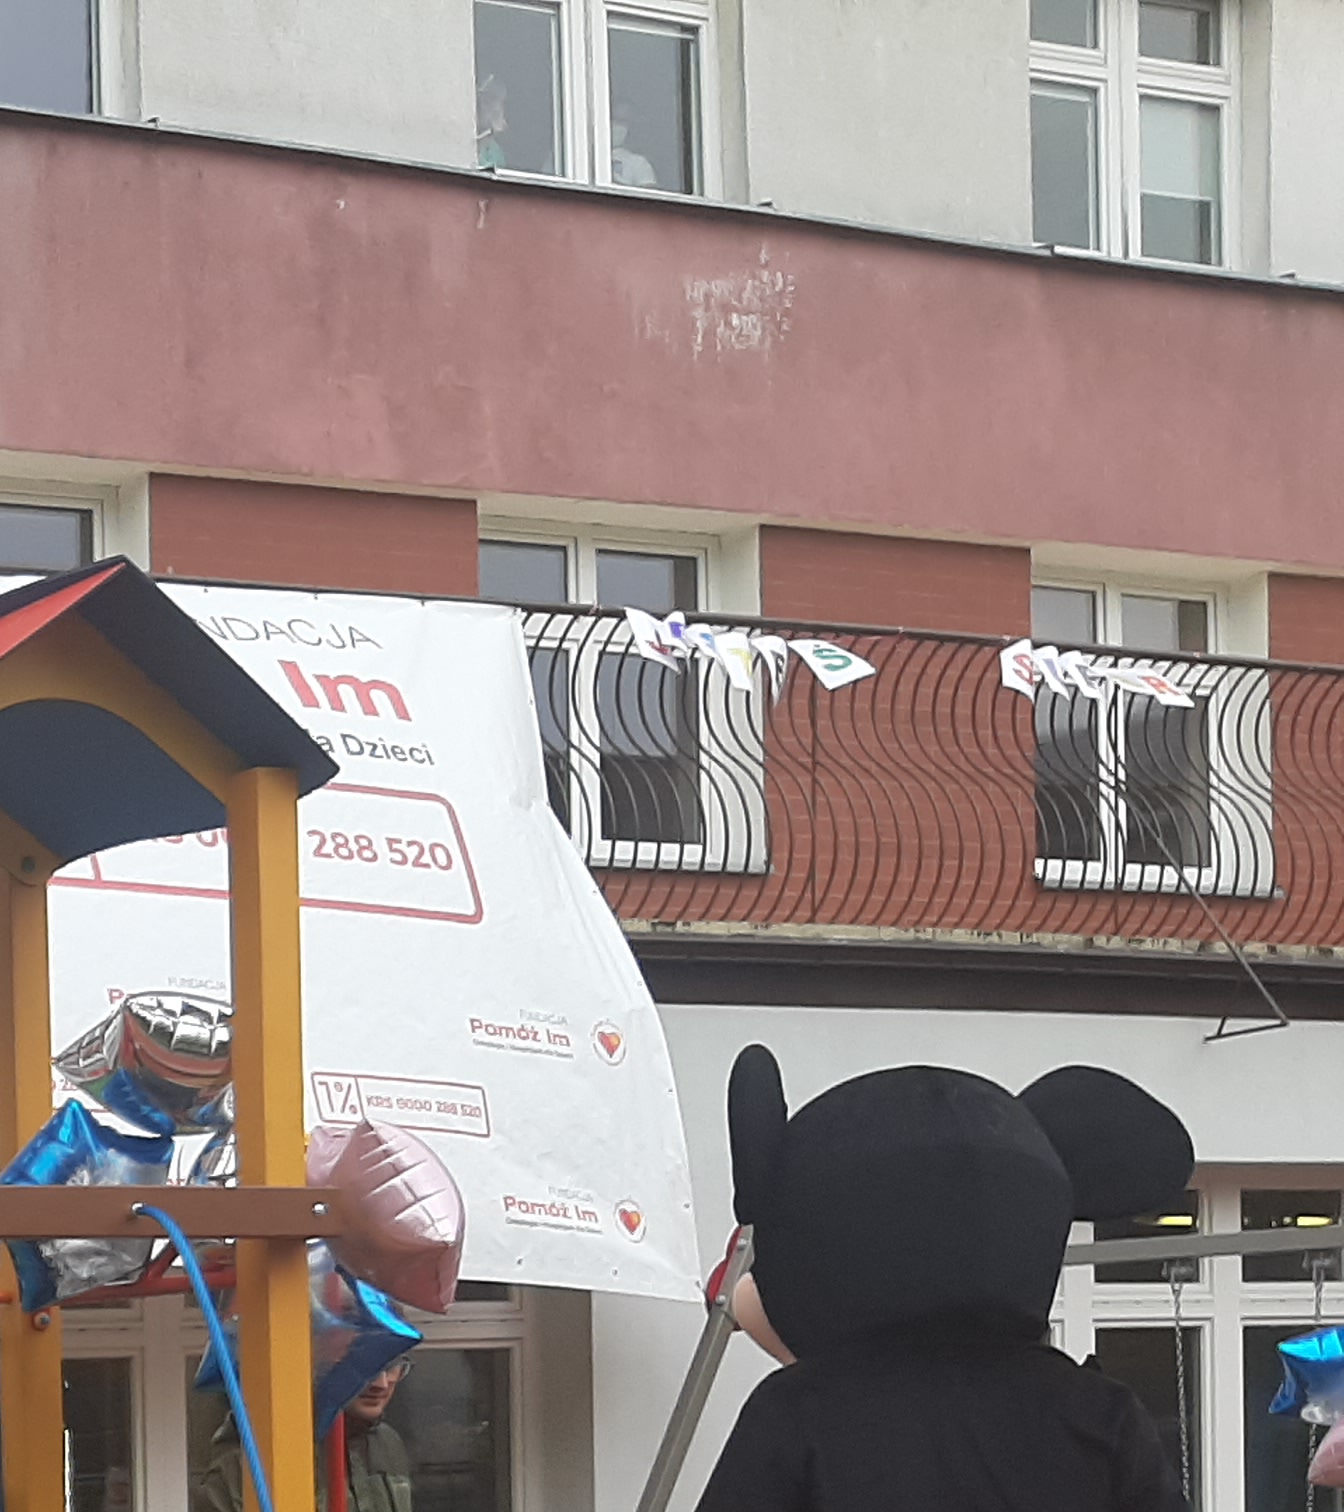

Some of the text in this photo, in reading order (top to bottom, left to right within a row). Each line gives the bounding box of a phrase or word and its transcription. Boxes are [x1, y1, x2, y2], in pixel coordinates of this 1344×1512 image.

[196, 616, 384, 650] NDACJA
[277, 659, 413, 722] Im
[340, 733, 435, 766] Dzieci
[306, 829, 454, 871] 288 520
[469, 1018, 541, 1043] Pomóż
[545, 1027, 571, 1048] Im
[503, 1195, 573, 1220] Pomóż
[574, 1204, 599, 1223] Im
